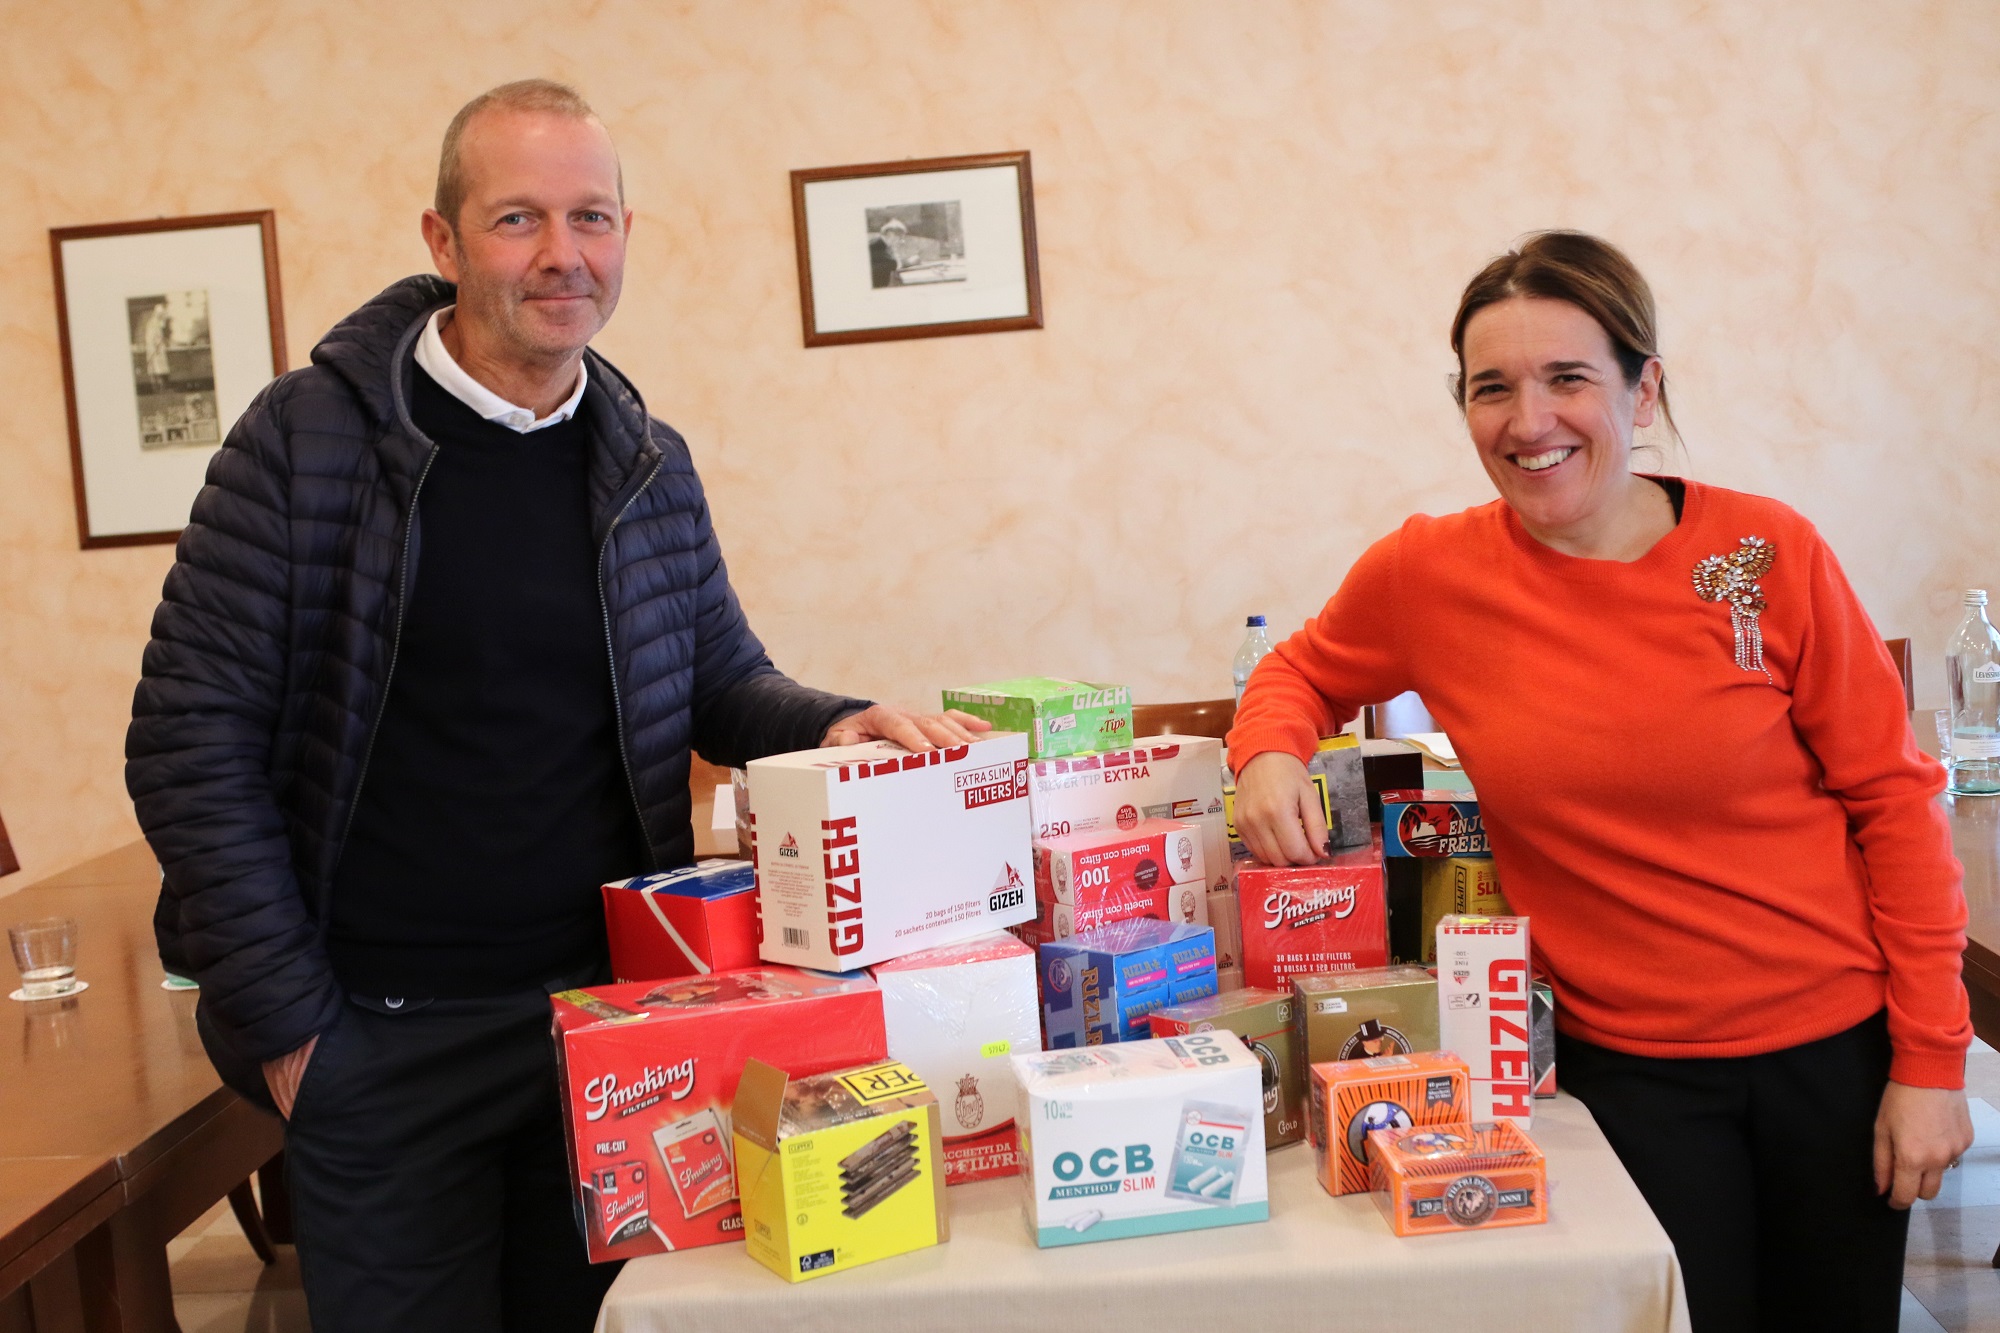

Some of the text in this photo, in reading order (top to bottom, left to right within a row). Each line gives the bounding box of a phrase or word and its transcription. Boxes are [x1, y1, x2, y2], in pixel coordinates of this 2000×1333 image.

[1072, 686, 1127, 710] GIZEH
[956, 767, 1011, 788] EXTRA SLIM
[1038, 766, 1150, 792] SILVER TIP EXTRA
[967, 782, 1012, 805] FILTERS
[1040, 820, 1071, 839] 250
[779, 848, 798, 858] GIZEH
[1080, 844, 1150, 865] tubetti con filtro
[821, 816, 864, 956] GIZEH
[1081, 866, 1110, 888] 100
[925, 900, 981, 919] 20 bags of 150 filters
[989, 889, 1024, 911] GIZEH
[1105, 905, 1122, 915] con
[1124, 898, 1153, 913] tubetti
[1264, 885, 1355, 929] Smoking
[895, 910, 982, 938] 20 sachets contenant 150 filtres
[1294, 913, 1326, 928] FILTERS
[1276, 954, 1285, 962] 30
[1287, 954, 1303, 962] BAGS
[1312, 953, 1323, 961] 120
[1326, 952, 1352, 960] FILTERS
[1273, 965, 1282, 973] 30
[1283, 964, 1307, 972] BOLSAS
[1330, 963, 1356, 971] FILTROS
[1277, 975, 1285, 983] 30
[1313, 1003, 1325, 1012] 33
[1488, 958, 1530, 1116] GIZEH
[1184, 1036, 1230, 1066] OCB
[584, 1058, 695, 1121] Smoking
[622, 1095, 660, 1116] FILTERS
[1044, 1100, 1059, 1120] 10
[596, 1139, 627, 1154] PRE-CUT
[996, 1143, 1011, 1153] DA
[1190, 1132, 1235, 1150] OCB
[680, 1154, 723, 1189] Smoking
[1052, 1143, 1154, 1181] OCB
[1056, 1176, 1155, 1197] MENTHOL SLIM
[606, 1191, 645, 1222] Smoking
